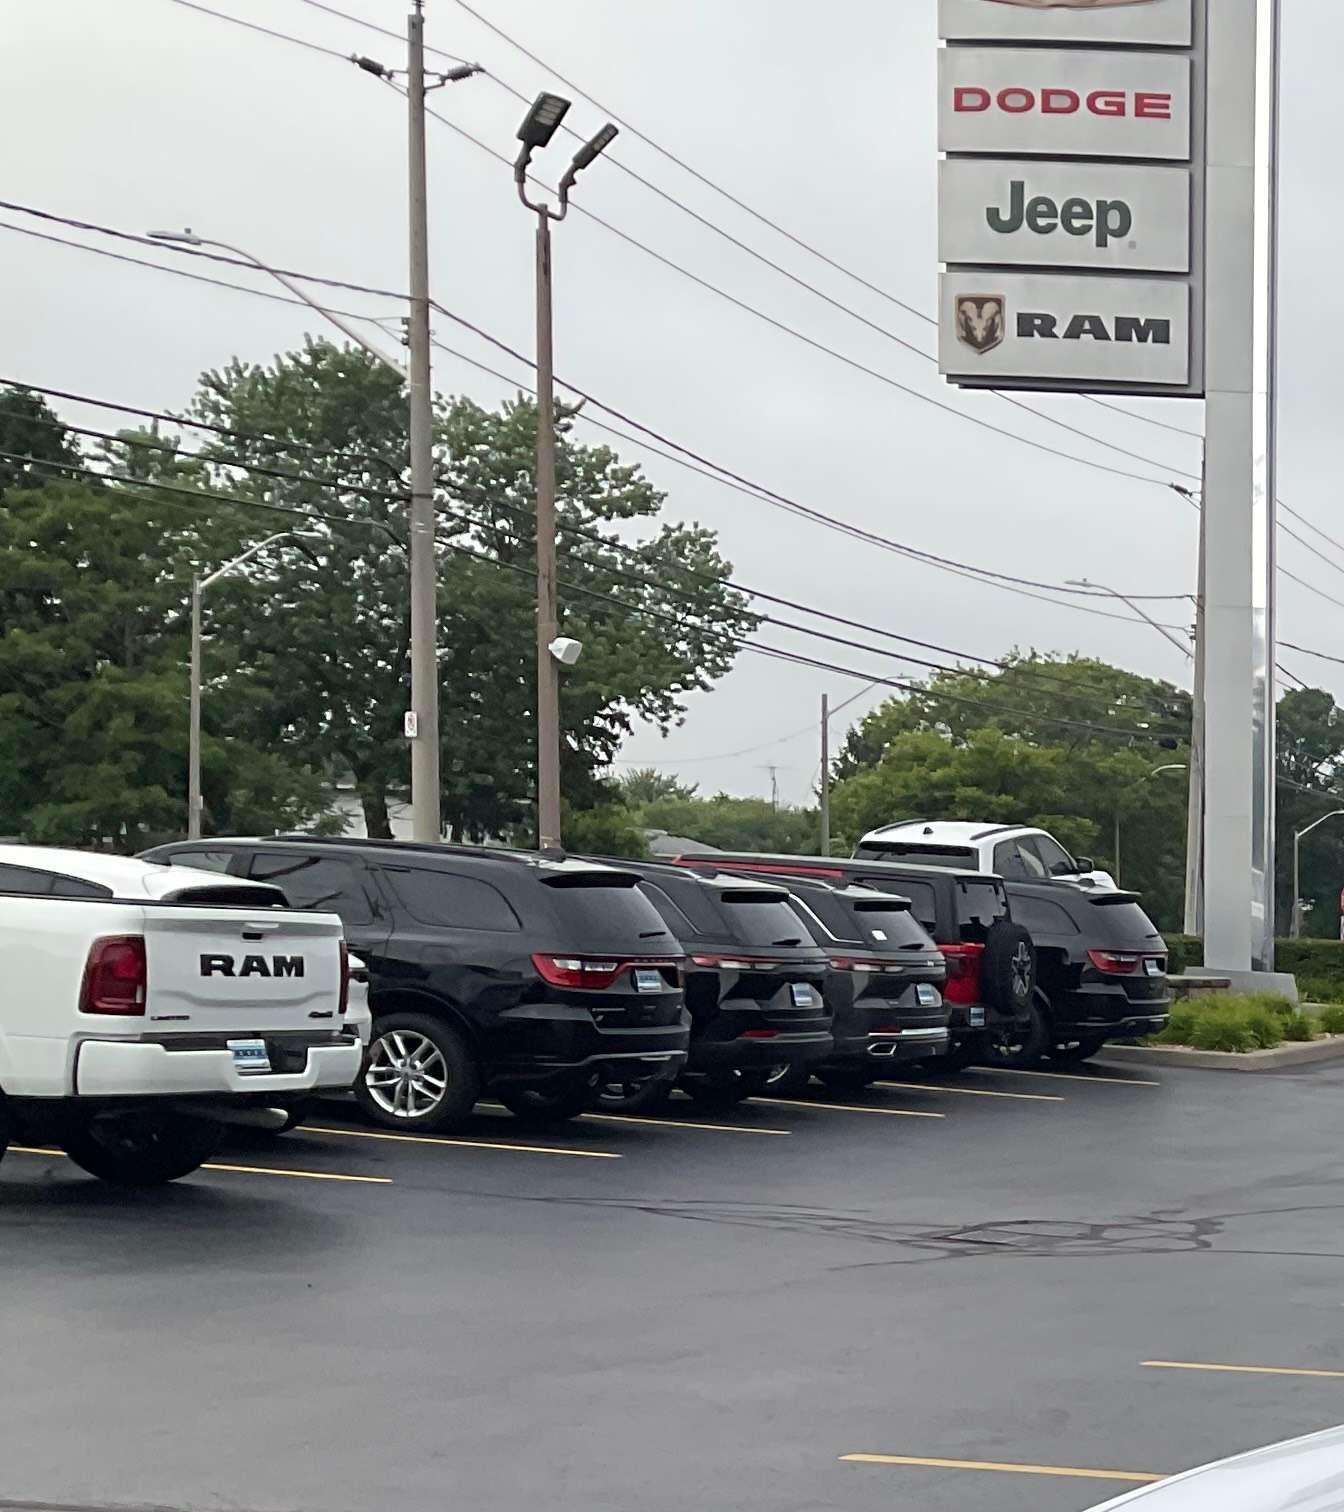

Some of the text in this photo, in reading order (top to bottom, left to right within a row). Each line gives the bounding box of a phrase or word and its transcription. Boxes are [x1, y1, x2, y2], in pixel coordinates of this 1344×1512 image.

[953, 86, 1172, 120] DODGE
[985, 180, 1132, 248] Jeep
[1016, 311, 1171, 345] RAM
[200, 953, 305, 978] RAM
